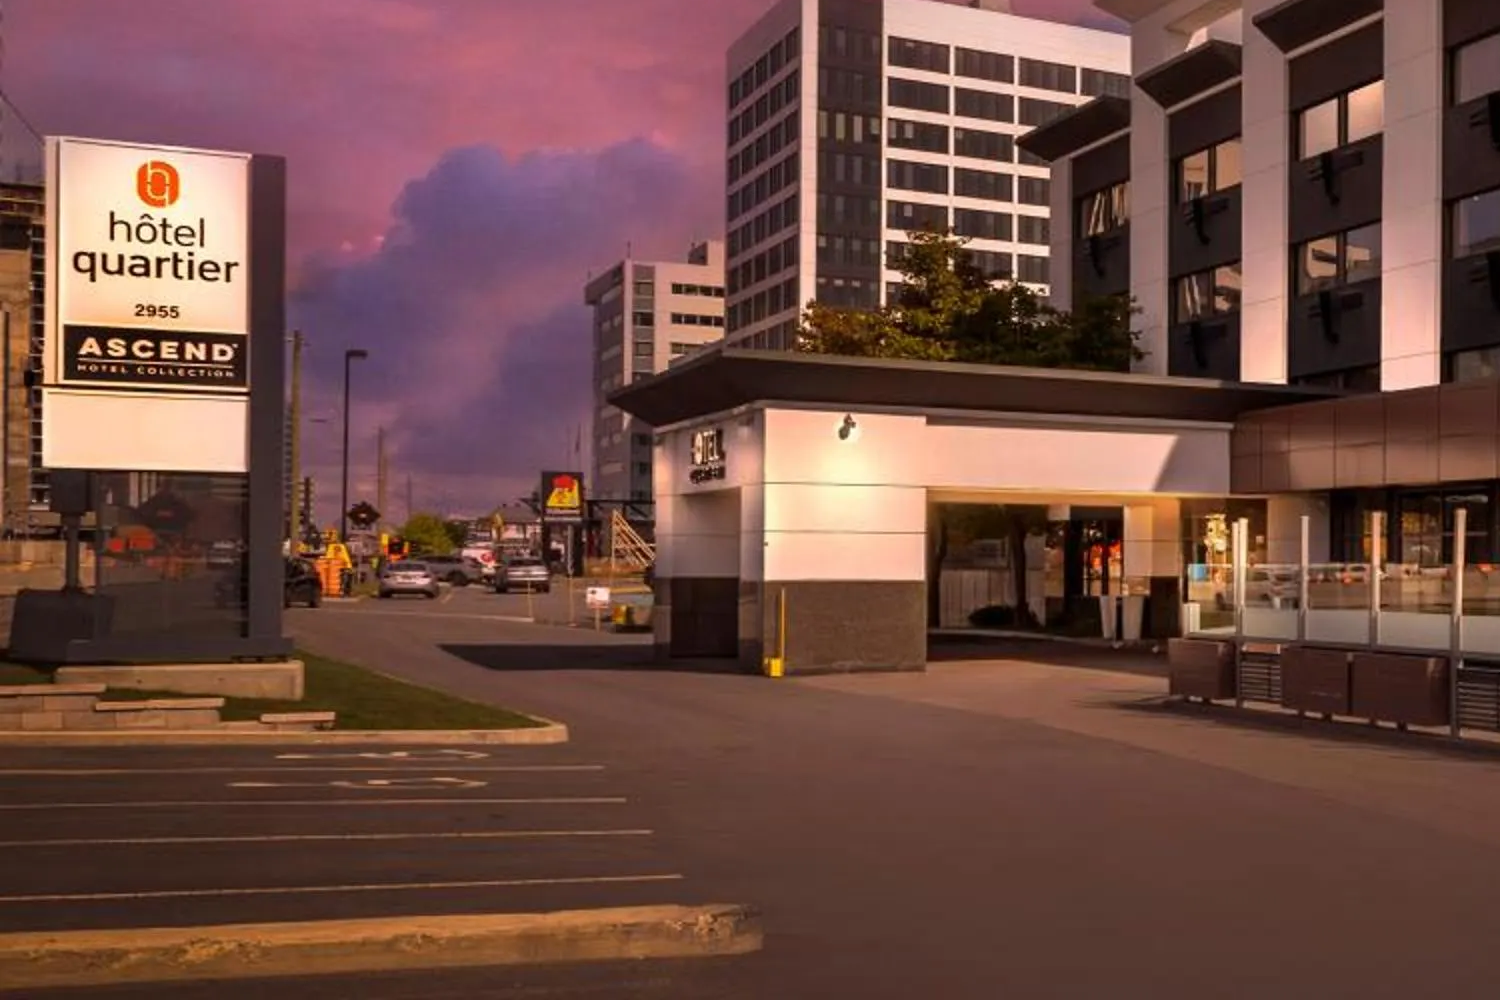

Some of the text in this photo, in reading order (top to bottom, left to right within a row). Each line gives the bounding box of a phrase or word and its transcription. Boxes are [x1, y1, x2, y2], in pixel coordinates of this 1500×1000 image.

[109, 210, 205, 248] hôtel
[72, 250, 240, 283] quartier
[134, 303, 180, 319] 2955
[78, 336, 235, 362] ASCEND
[77, 363, 235, 378] HOTEL COLLECTION
